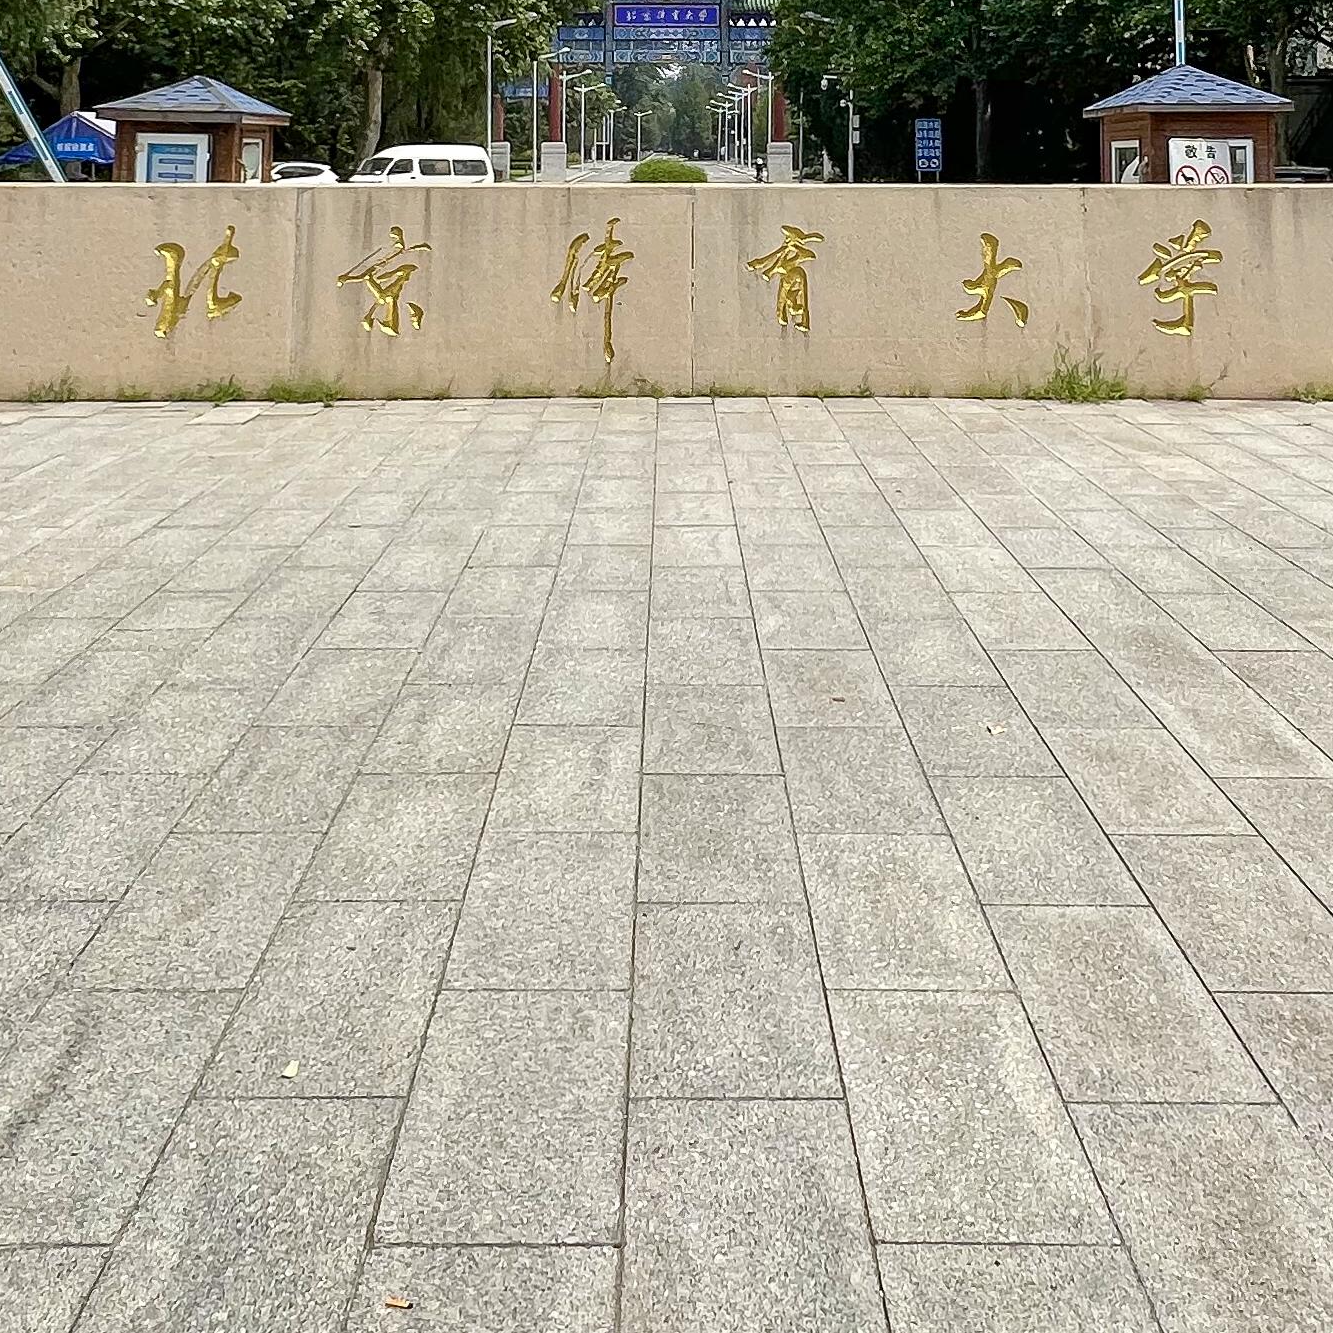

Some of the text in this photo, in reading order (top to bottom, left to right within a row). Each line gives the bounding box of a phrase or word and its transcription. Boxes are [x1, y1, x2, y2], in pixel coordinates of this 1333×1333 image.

[1184, 144, 1217, 159] 敬告
[144, 217, 1224, 364] 北京体育大学
